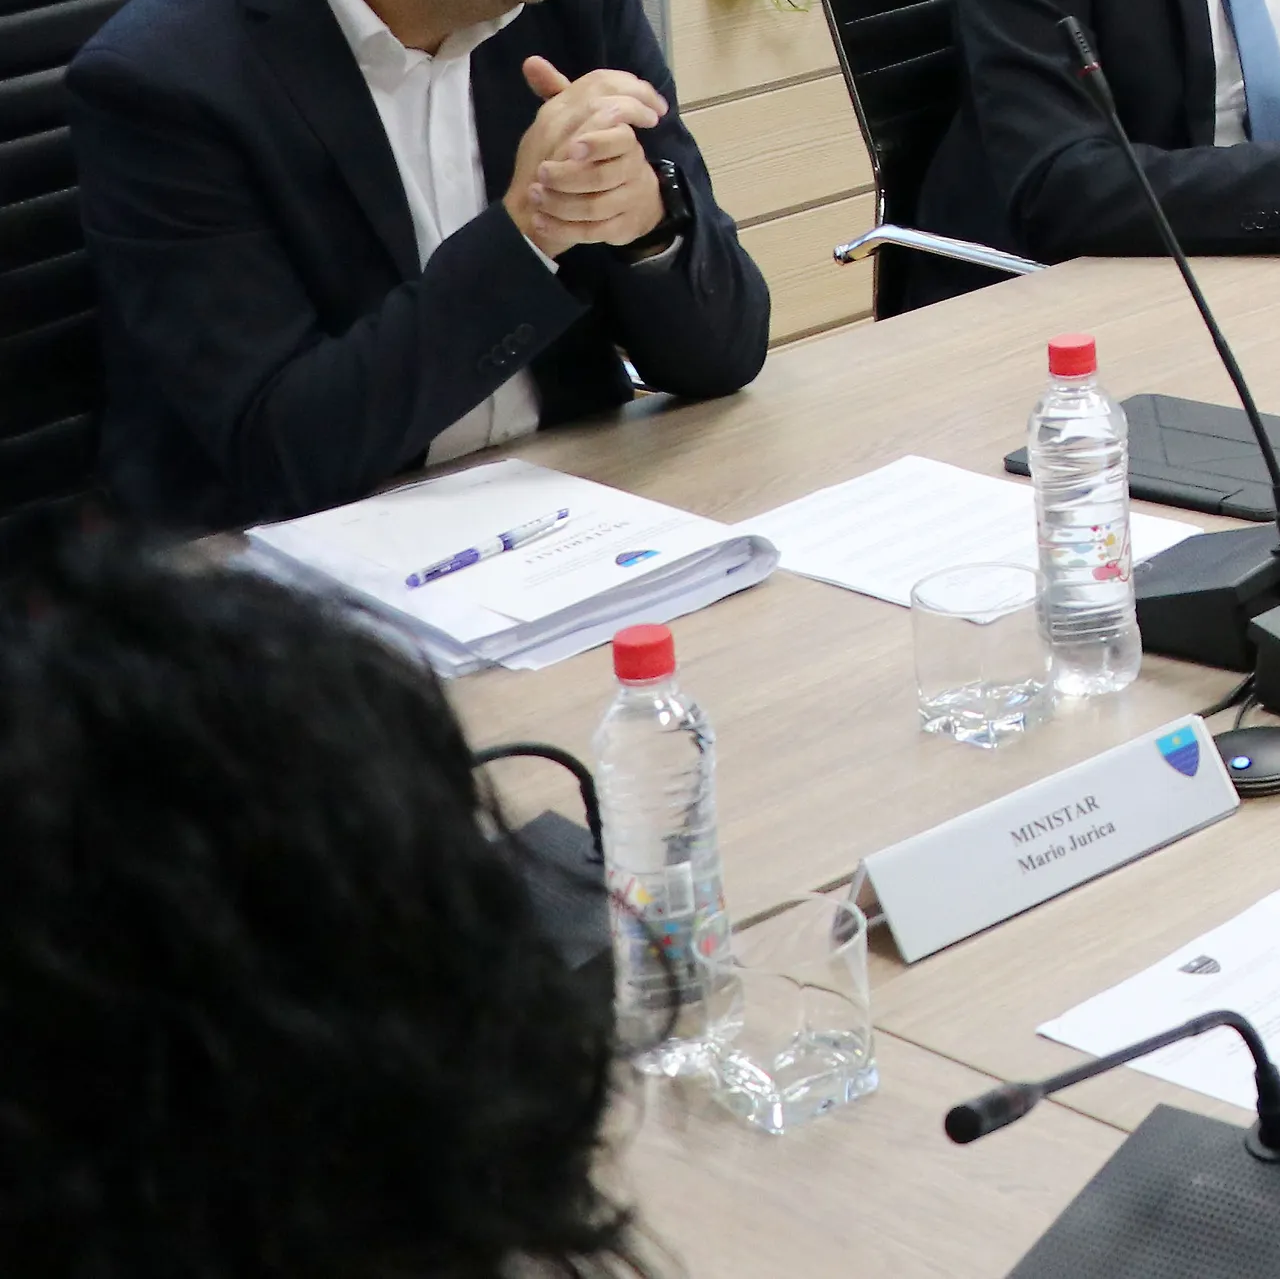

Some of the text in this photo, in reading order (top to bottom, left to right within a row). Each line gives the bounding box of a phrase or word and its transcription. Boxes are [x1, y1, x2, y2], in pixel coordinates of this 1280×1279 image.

[1009, 795, 1100, 847] MINISTAR
[1016, 822, 1116, 874] Mario Jurica
